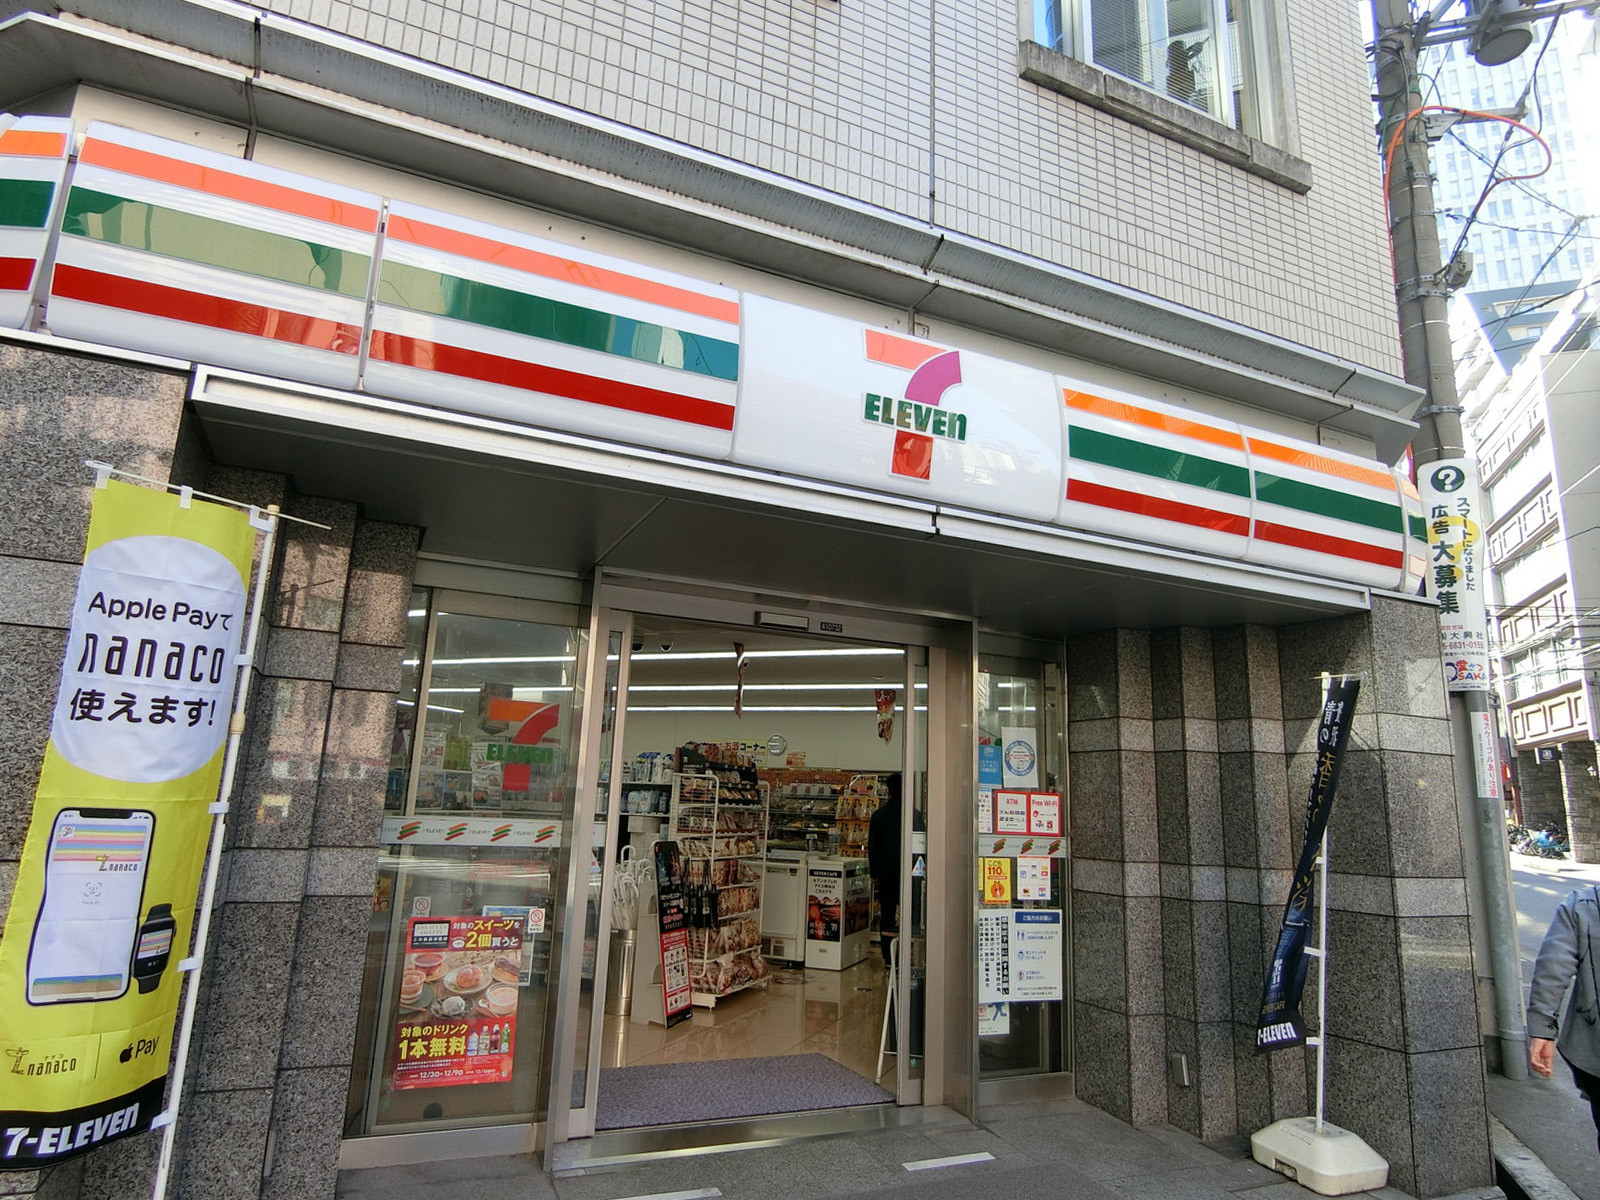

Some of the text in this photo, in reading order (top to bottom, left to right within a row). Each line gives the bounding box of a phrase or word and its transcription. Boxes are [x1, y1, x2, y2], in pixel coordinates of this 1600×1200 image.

[1457, 497, 1476, 592] スマートになりました
[1432, 504, 1460, 615] 広告大募集
[88, 591, 167, 623] Apple
[78, 633, 225, 684] nanaco
[109, 863, 138, 871] nanaco
[987, 866, 1003, 876] 110
[452, 919, 520, 931] 対象のスイーツを
[465, 931, 519, 948] 2個買うと
[400, 1024, 469, 1038] 対象のドリンク
[135, 1035, 160, 1057] Pay
[399, 1035, 466, 1060] 1本無料
[27, 1058, 77, 1075] nanaco
